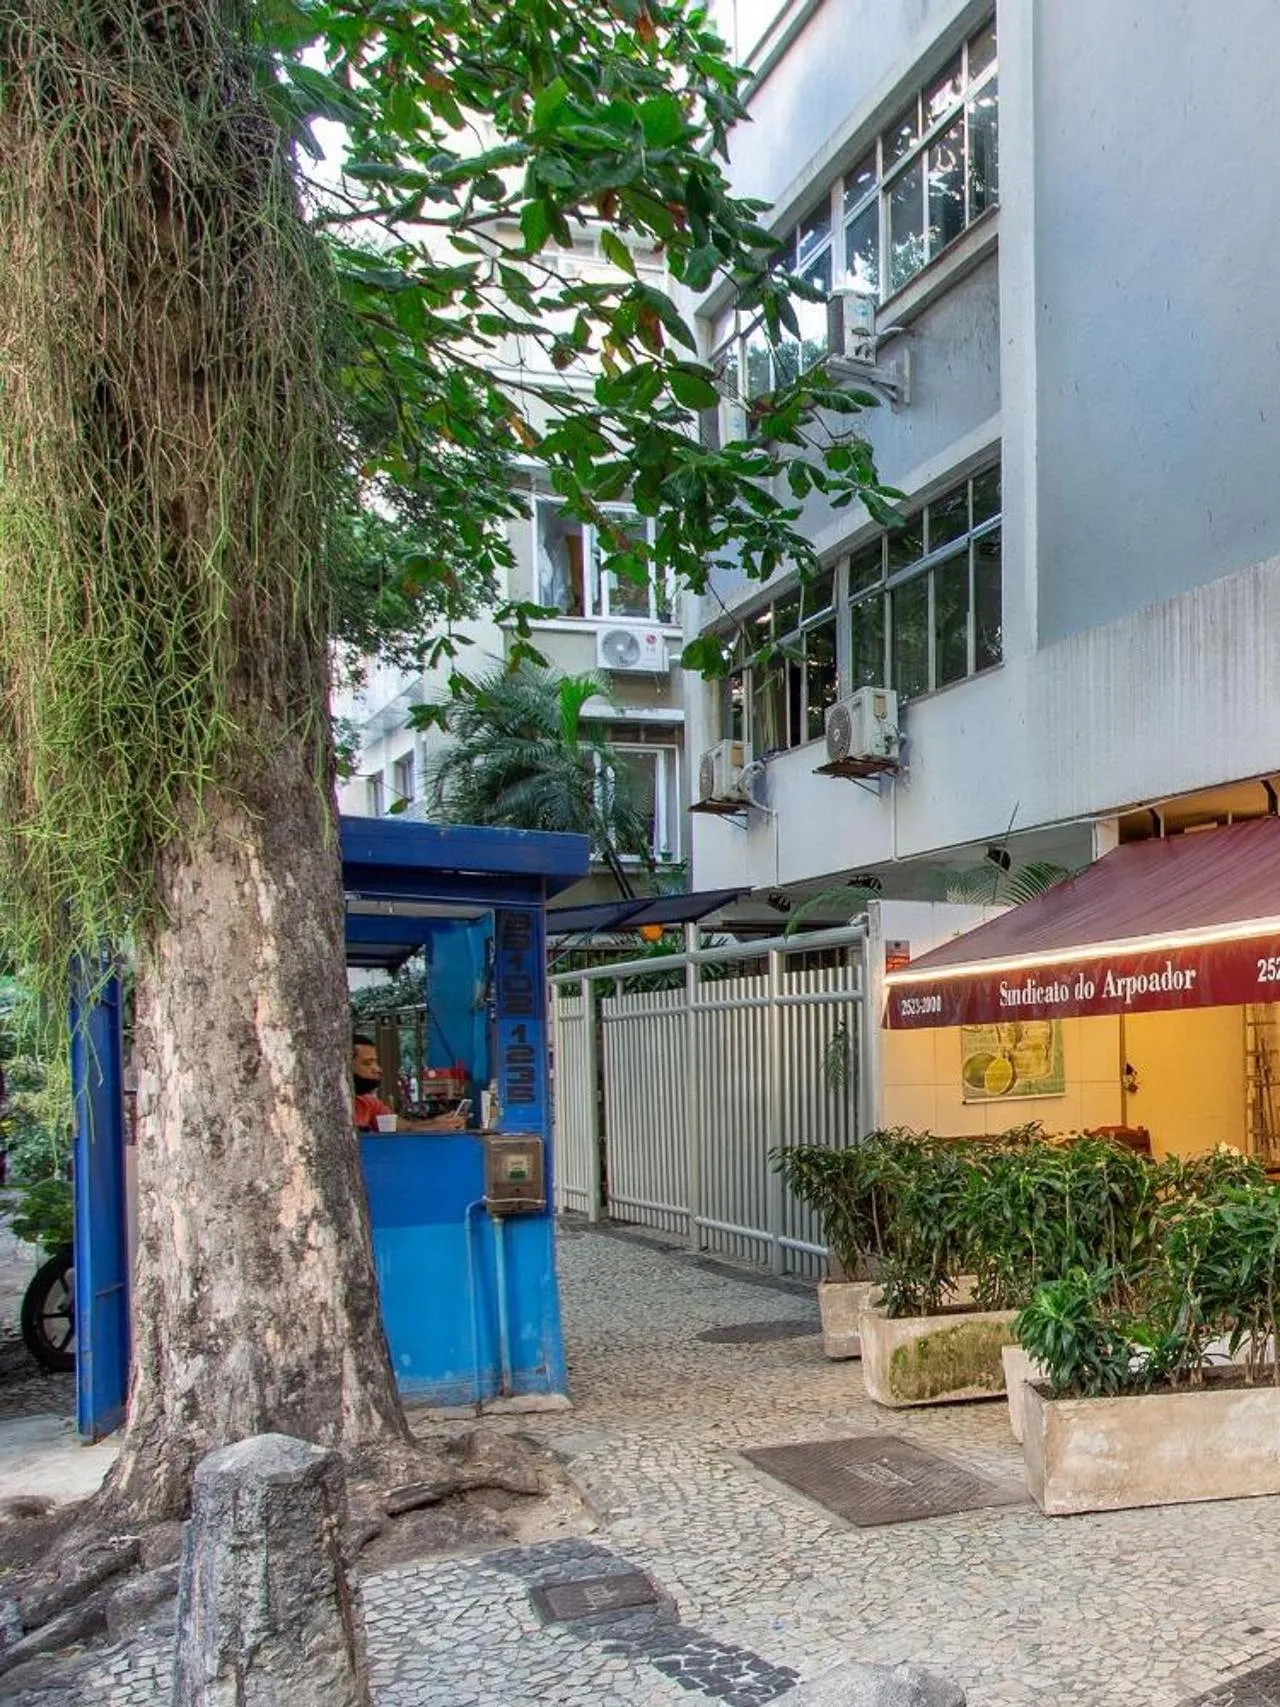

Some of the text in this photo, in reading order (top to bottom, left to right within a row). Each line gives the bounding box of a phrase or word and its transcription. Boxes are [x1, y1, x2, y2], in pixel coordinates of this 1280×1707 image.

[999, 961, 1197, 1008] Sindicato do Arpoador
